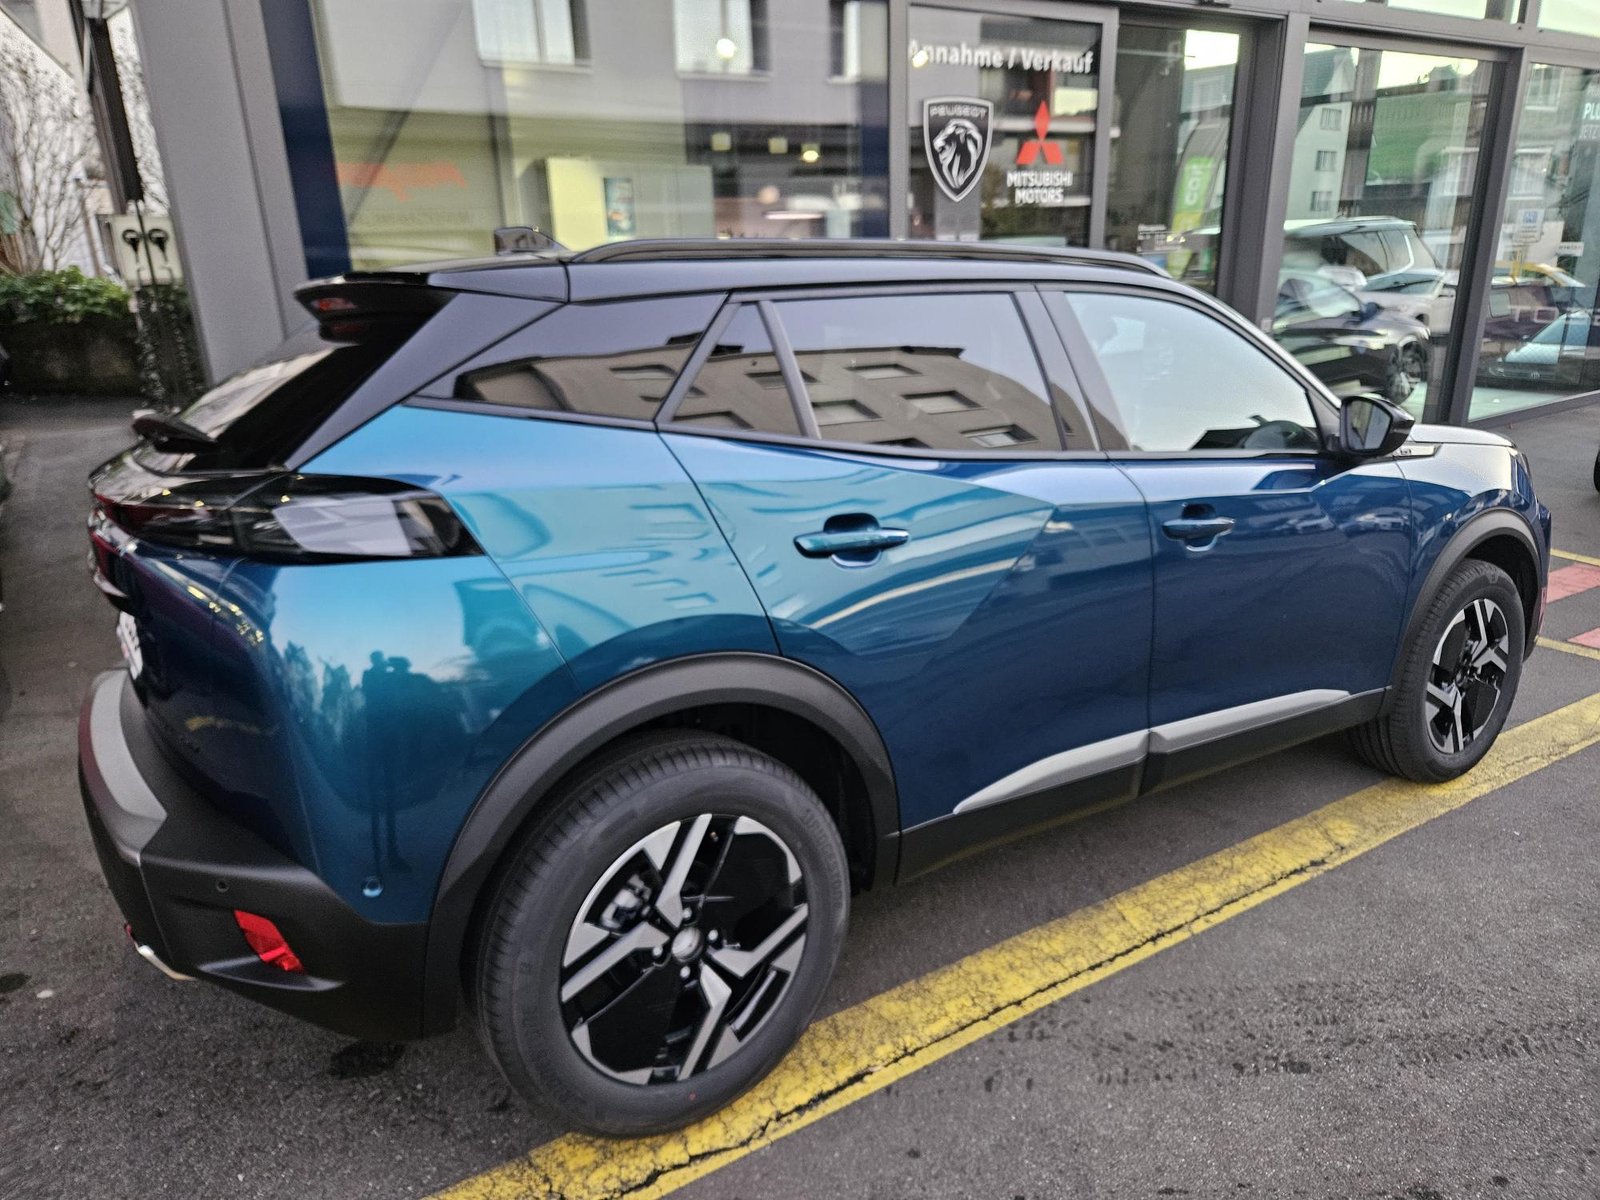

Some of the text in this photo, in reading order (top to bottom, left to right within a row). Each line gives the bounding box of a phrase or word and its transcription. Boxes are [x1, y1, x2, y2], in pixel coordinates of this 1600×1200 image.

[908, 39, 1094, 74] Annahme / Verkauf
[929, 104, 988, 120] PEUGEOT
[1007, 170, 1073, 187] MITSUBISHI
[1015, 188, 1064, 204] MOTORS
